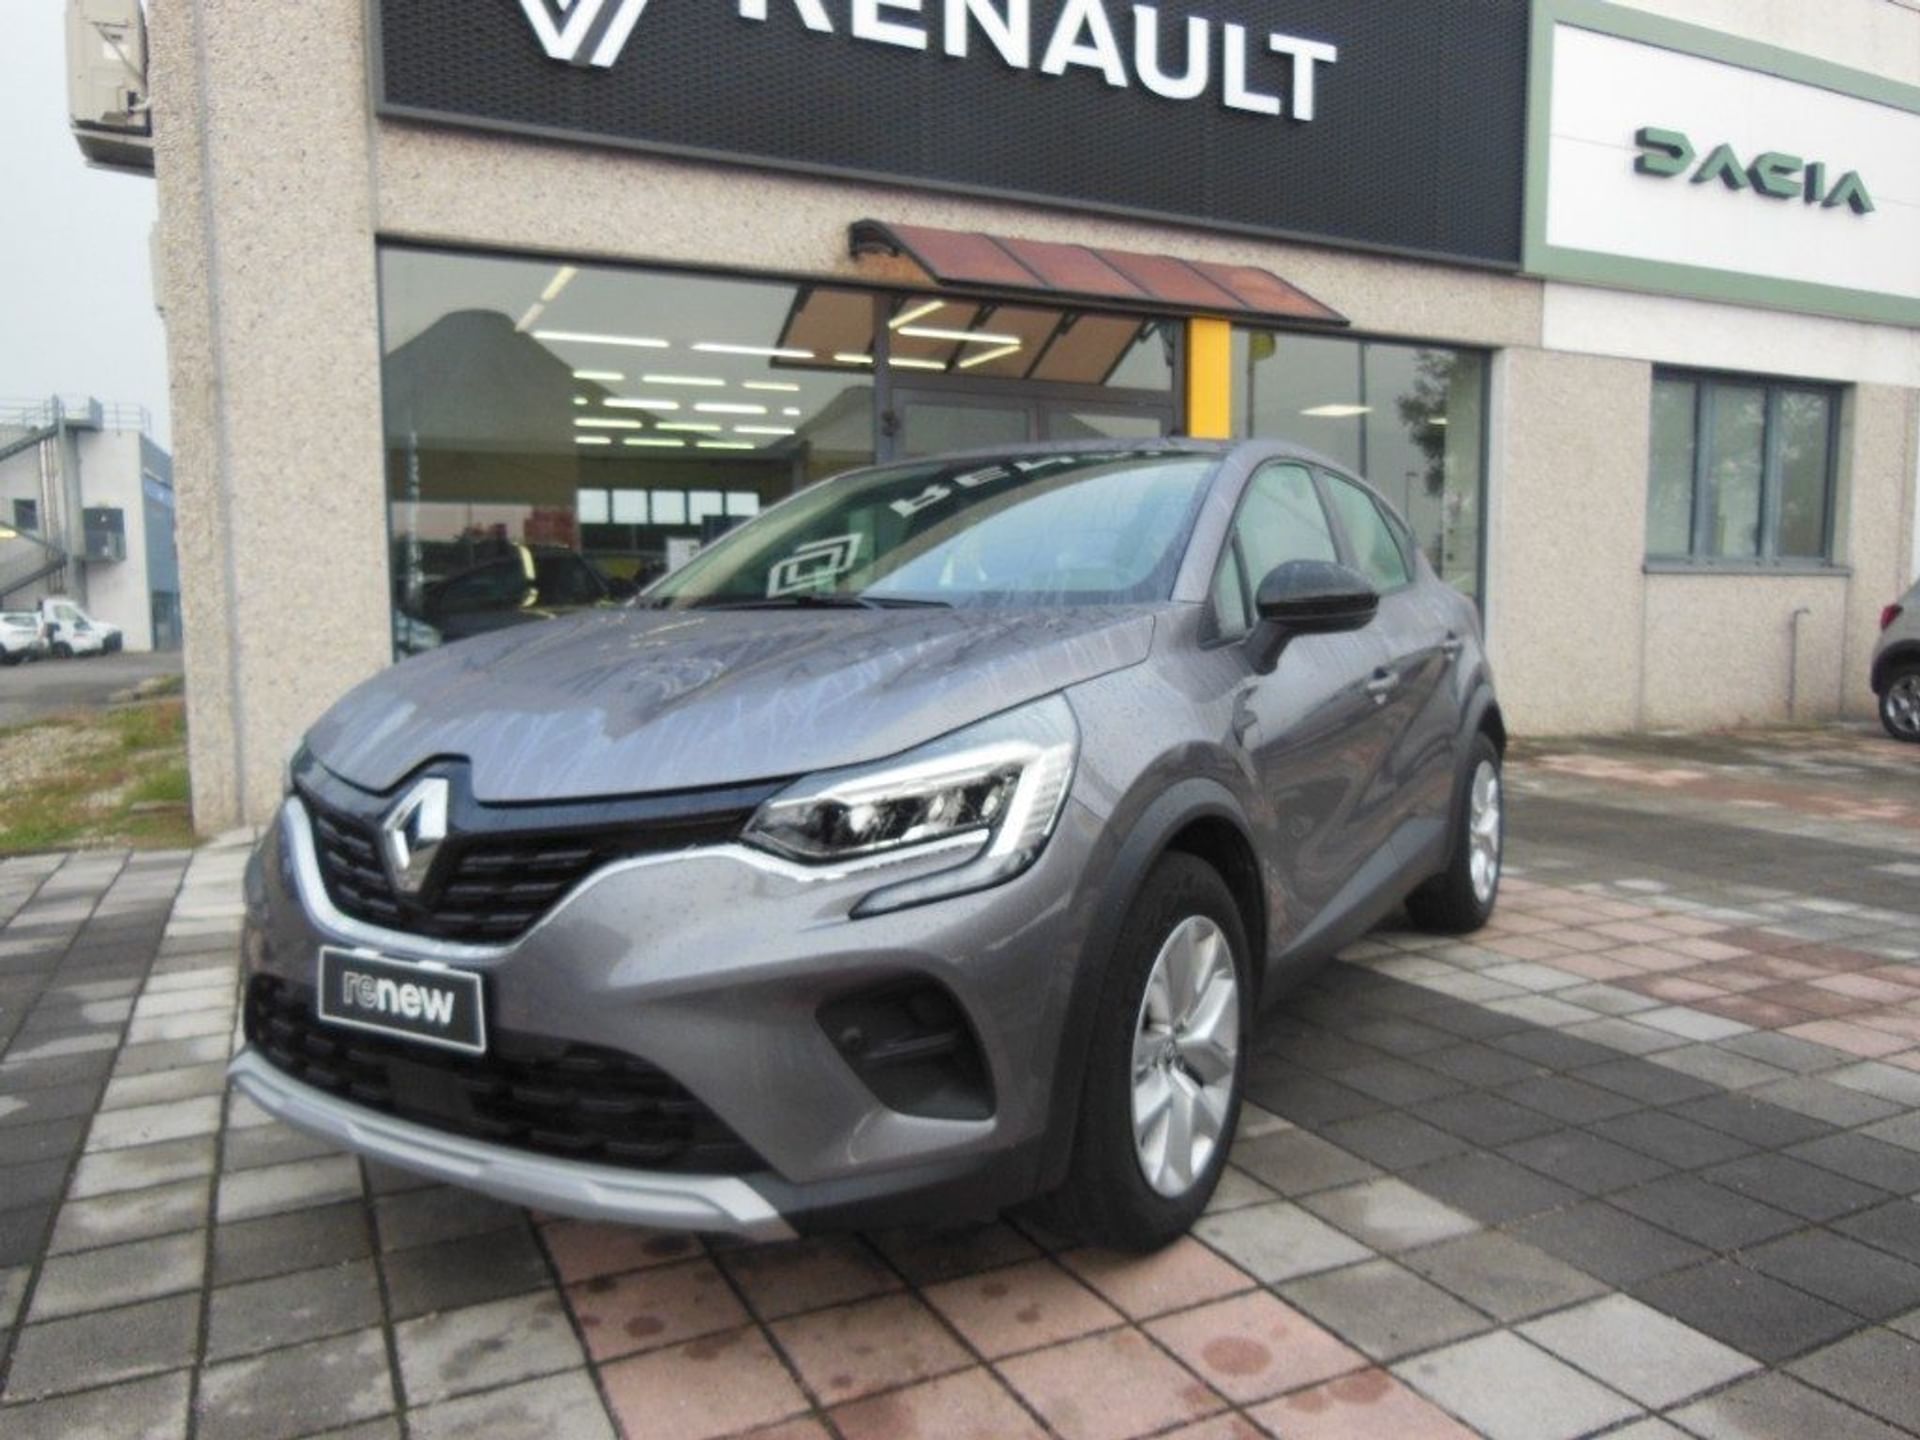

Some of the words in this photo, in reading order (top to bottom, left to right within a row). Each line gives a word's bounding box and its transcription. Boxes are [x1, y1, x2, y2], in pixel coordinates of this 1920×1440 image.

[739, 0, 1338, 122] NAULT
[1634, 126, 1875, 214] DACIA
[343, 971, 454, 1025] renew
